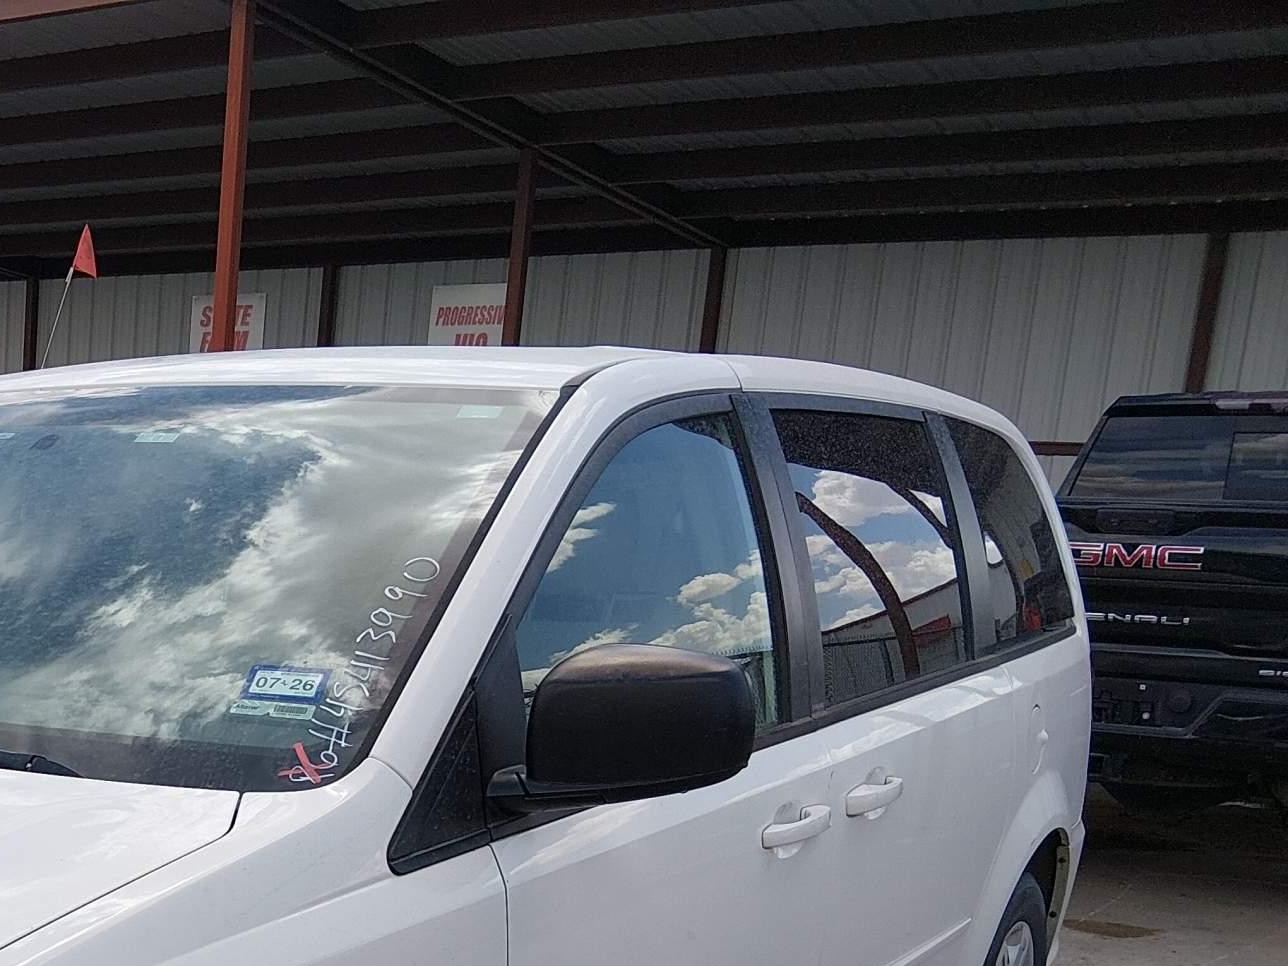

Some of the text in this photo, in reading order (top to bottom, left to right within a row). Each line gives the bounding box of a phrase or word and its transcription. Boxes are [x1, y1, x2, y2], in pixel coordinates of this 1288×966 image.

[199, 304, 254, 328] STE
[435, 304, 505, 327] PROGRESSIV
[1068, 541, 1205, 571] GMC
[1084, 612, 1191, 625] ENALI
